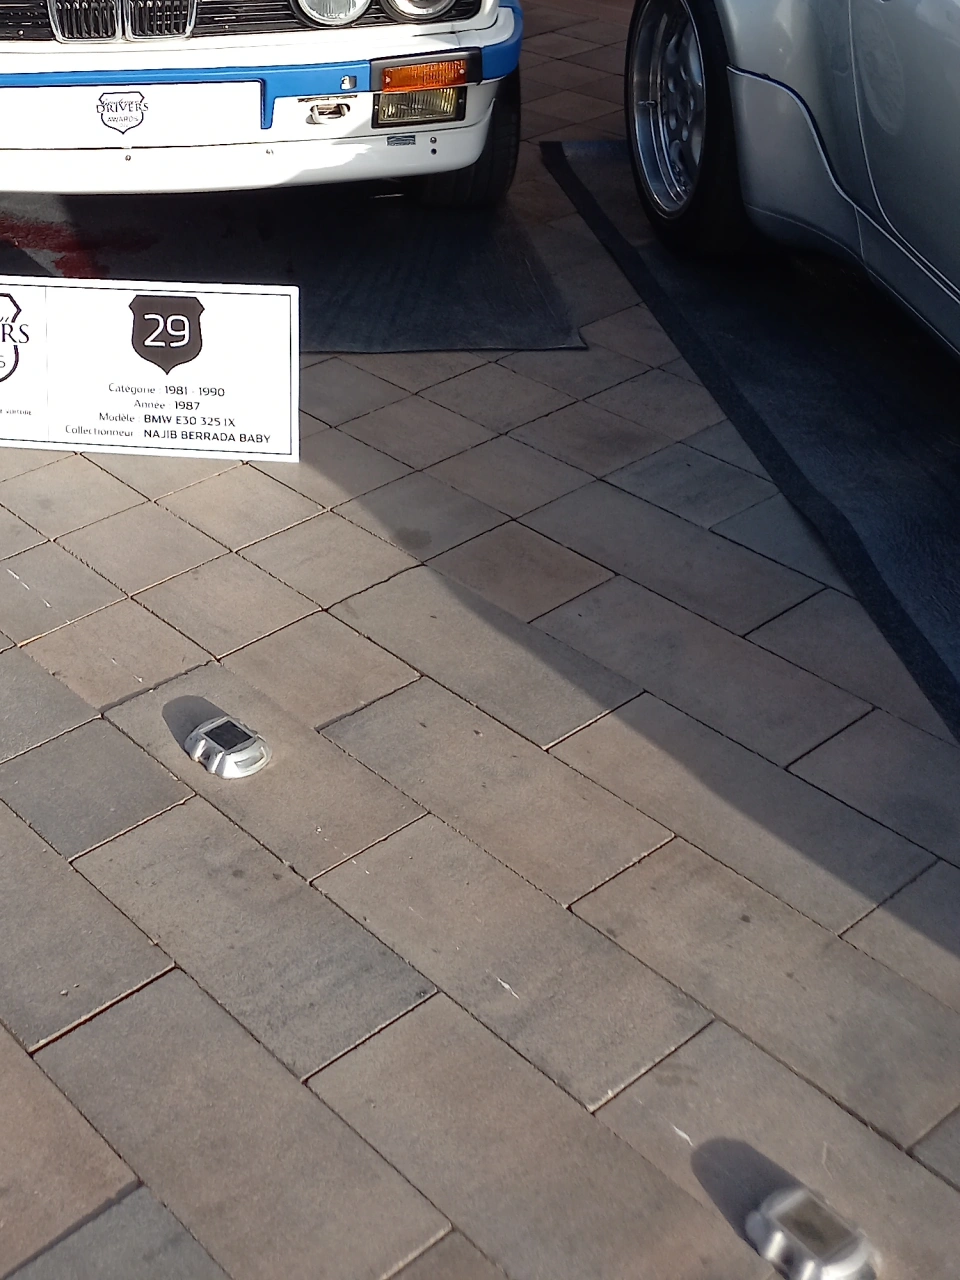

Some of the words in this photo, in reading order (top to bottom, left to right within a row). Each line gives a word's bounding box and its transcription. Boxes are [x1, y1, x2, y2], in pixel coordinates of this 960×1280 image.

[96, 102, 148, 113] DRIVERS
[143, 314, 190, 348] 29
[165, 386, 188, 395] 1981
[198, 387, 225, 397] 1990
[174, 401, 200, 410] 1987
[144, 414, 172, 424] BMW
[176, 416, 197, 425] E30
[200, 417, 221, 426] 325
[224, 418, 236, 427] IX
[144, 429, 177, 439] NAJIB
[181, 431, 236, 442] BERRADA
[239, 433, 271, 443] BABY
